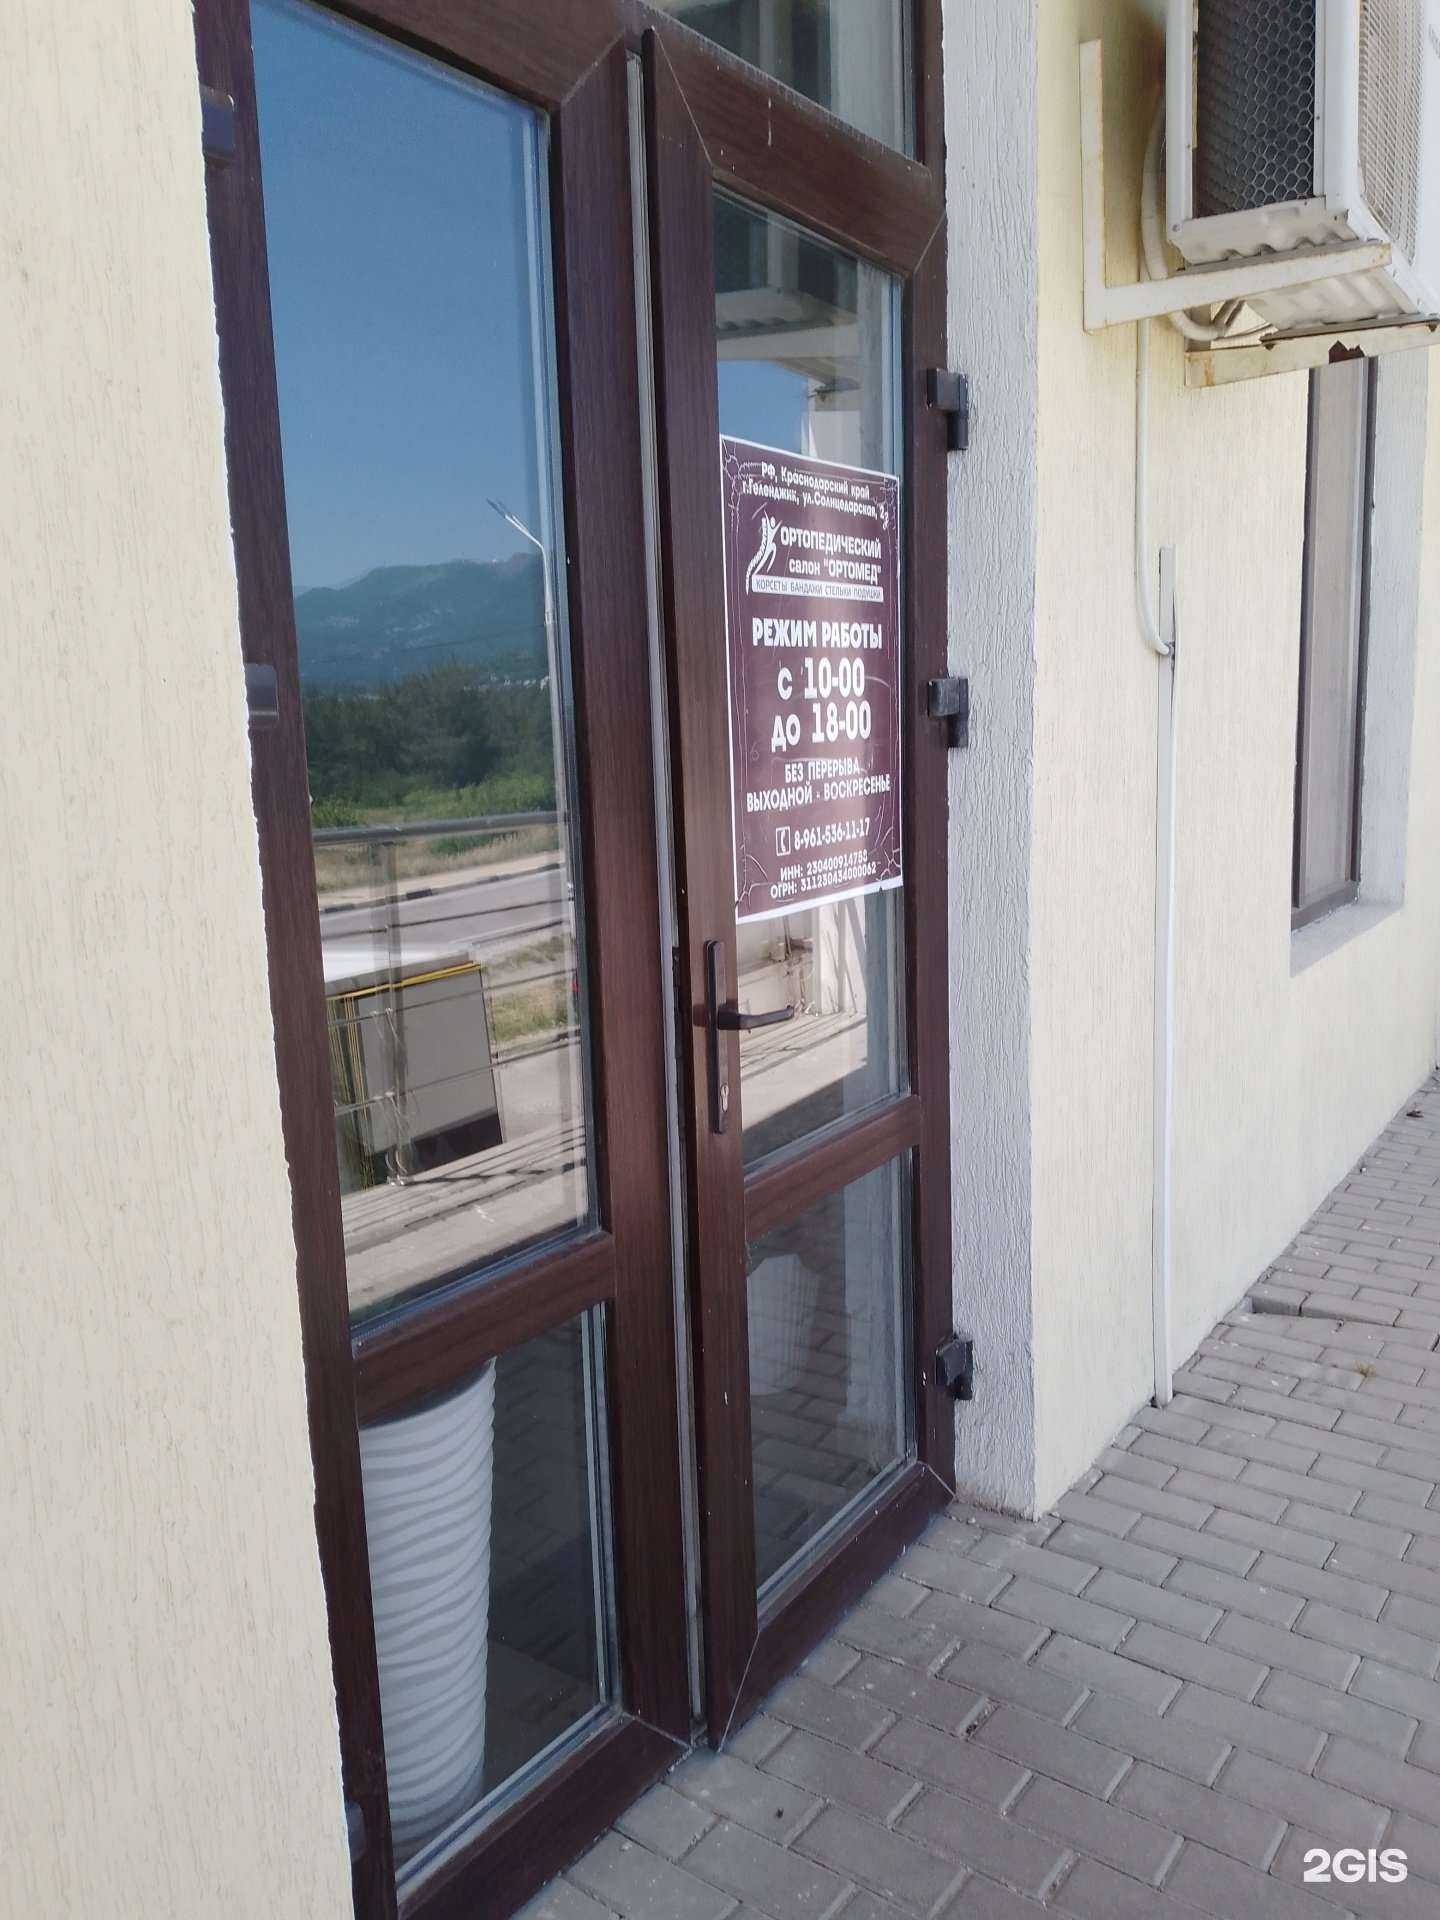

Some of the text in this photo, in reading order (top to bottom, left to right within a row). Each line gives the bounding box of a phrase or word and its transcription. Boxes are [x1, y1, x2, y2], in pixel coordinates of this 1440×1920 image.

[761, 461, 870, 500] РФ, Краснодарский край
[781, 526, 881, 559] ОРТОПЕДИЧЕСКИЙ
[789, 559, 820, 575] салон
[756, 579, 787, 592] КОРСЕТЫ
[752, 617, 883, 649] РЕЖИМ РАБОТЫ
[804, 656, 866, 699] 10-00
[812, 701, 872, 743] 18-00
[785, 759, 859, 783] БЕЗ ПЕРЕРЫВА
[746, 782, 812, 812] ВЫХОДНОЙ
[824, 774, 890, 800] ВОСКРЕСЕНЬЕ
[795, 818, 870, 850] 8-961-536-11-17
[780, 863, 803, 881] ИНН:
[770, 880, 797, 899] ОГРН:
